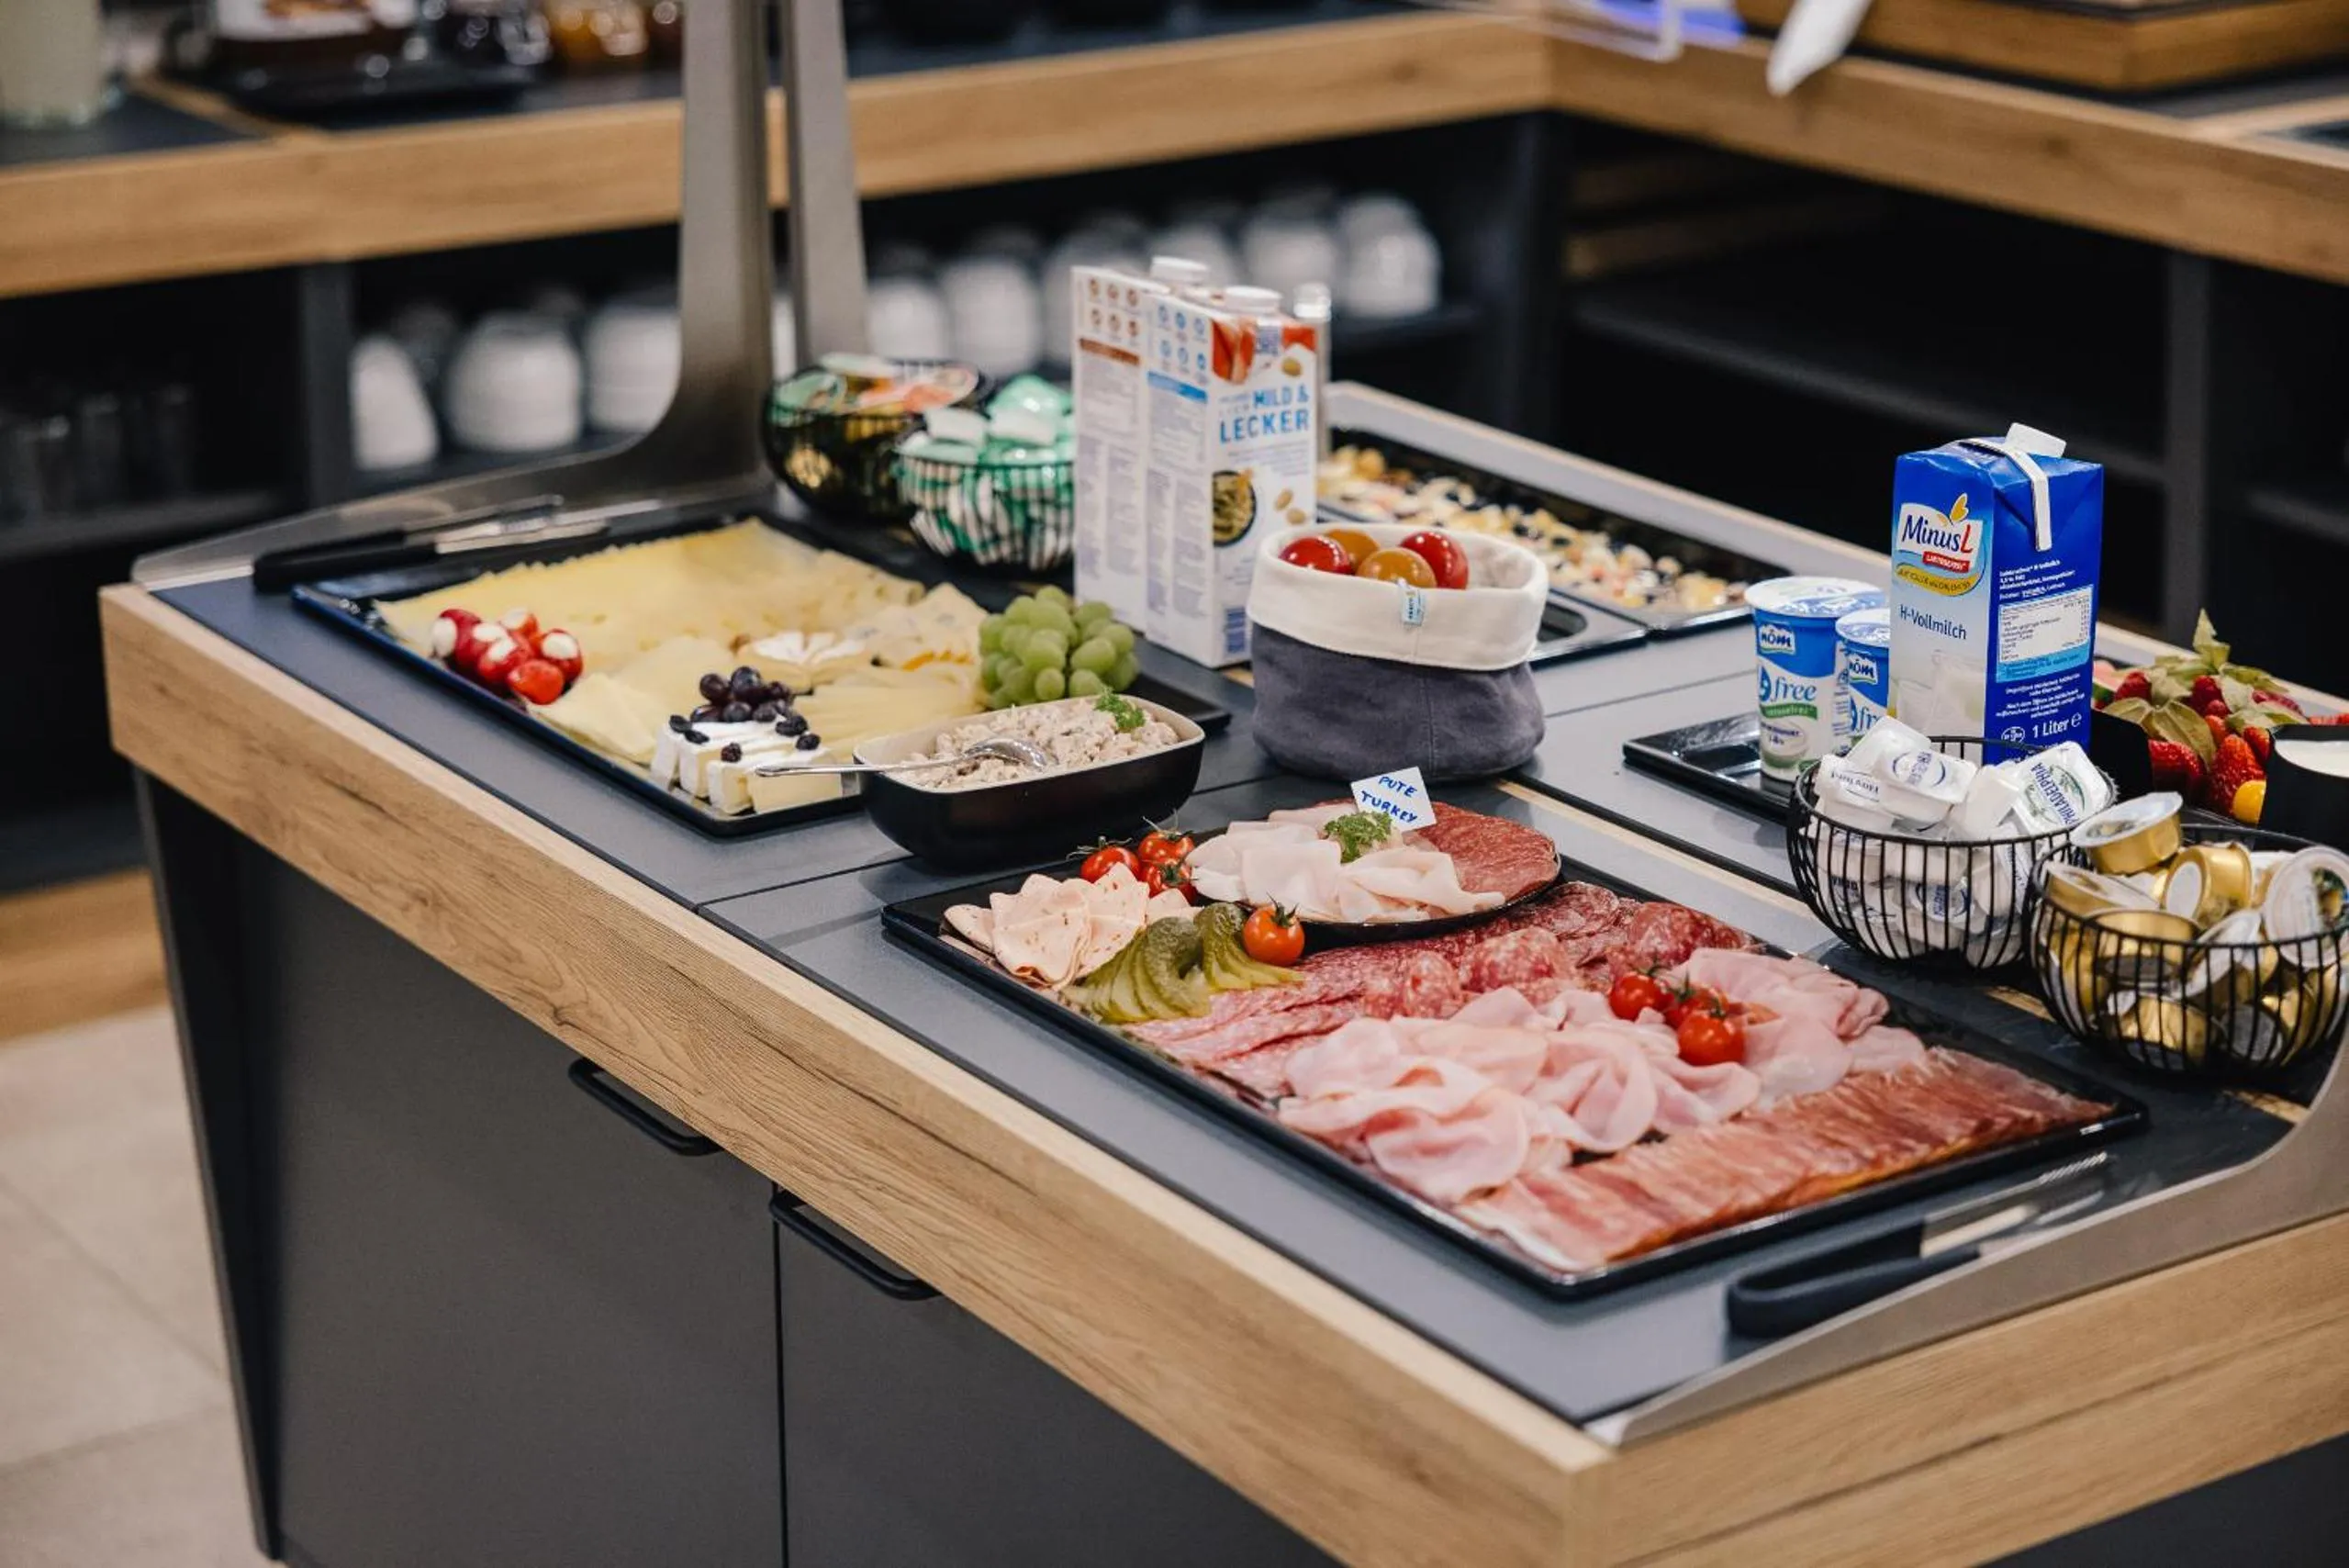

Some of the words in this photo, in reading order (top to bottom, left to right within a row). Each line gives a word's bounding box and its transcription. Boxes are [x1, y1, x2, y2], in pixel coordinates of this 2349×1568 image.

[1253, 386, 1292, 409] MILD
[1220, 409, 1310, 444] LECKER
[1901, 514, 1974, 554] MinusL
[1899, 604, 1967, 640] H-Vollmilch
[1770, 675, 1818, 702] free
[2031, 724, 2039, 739] 1
[2042, 719, 2070, 737] Liter
[1378, 776, 1418, 798] PUTE
[2030, 762, 2081, 826] PHILADELPHIA
[1361, 790, 1418, 823] TURKEY
